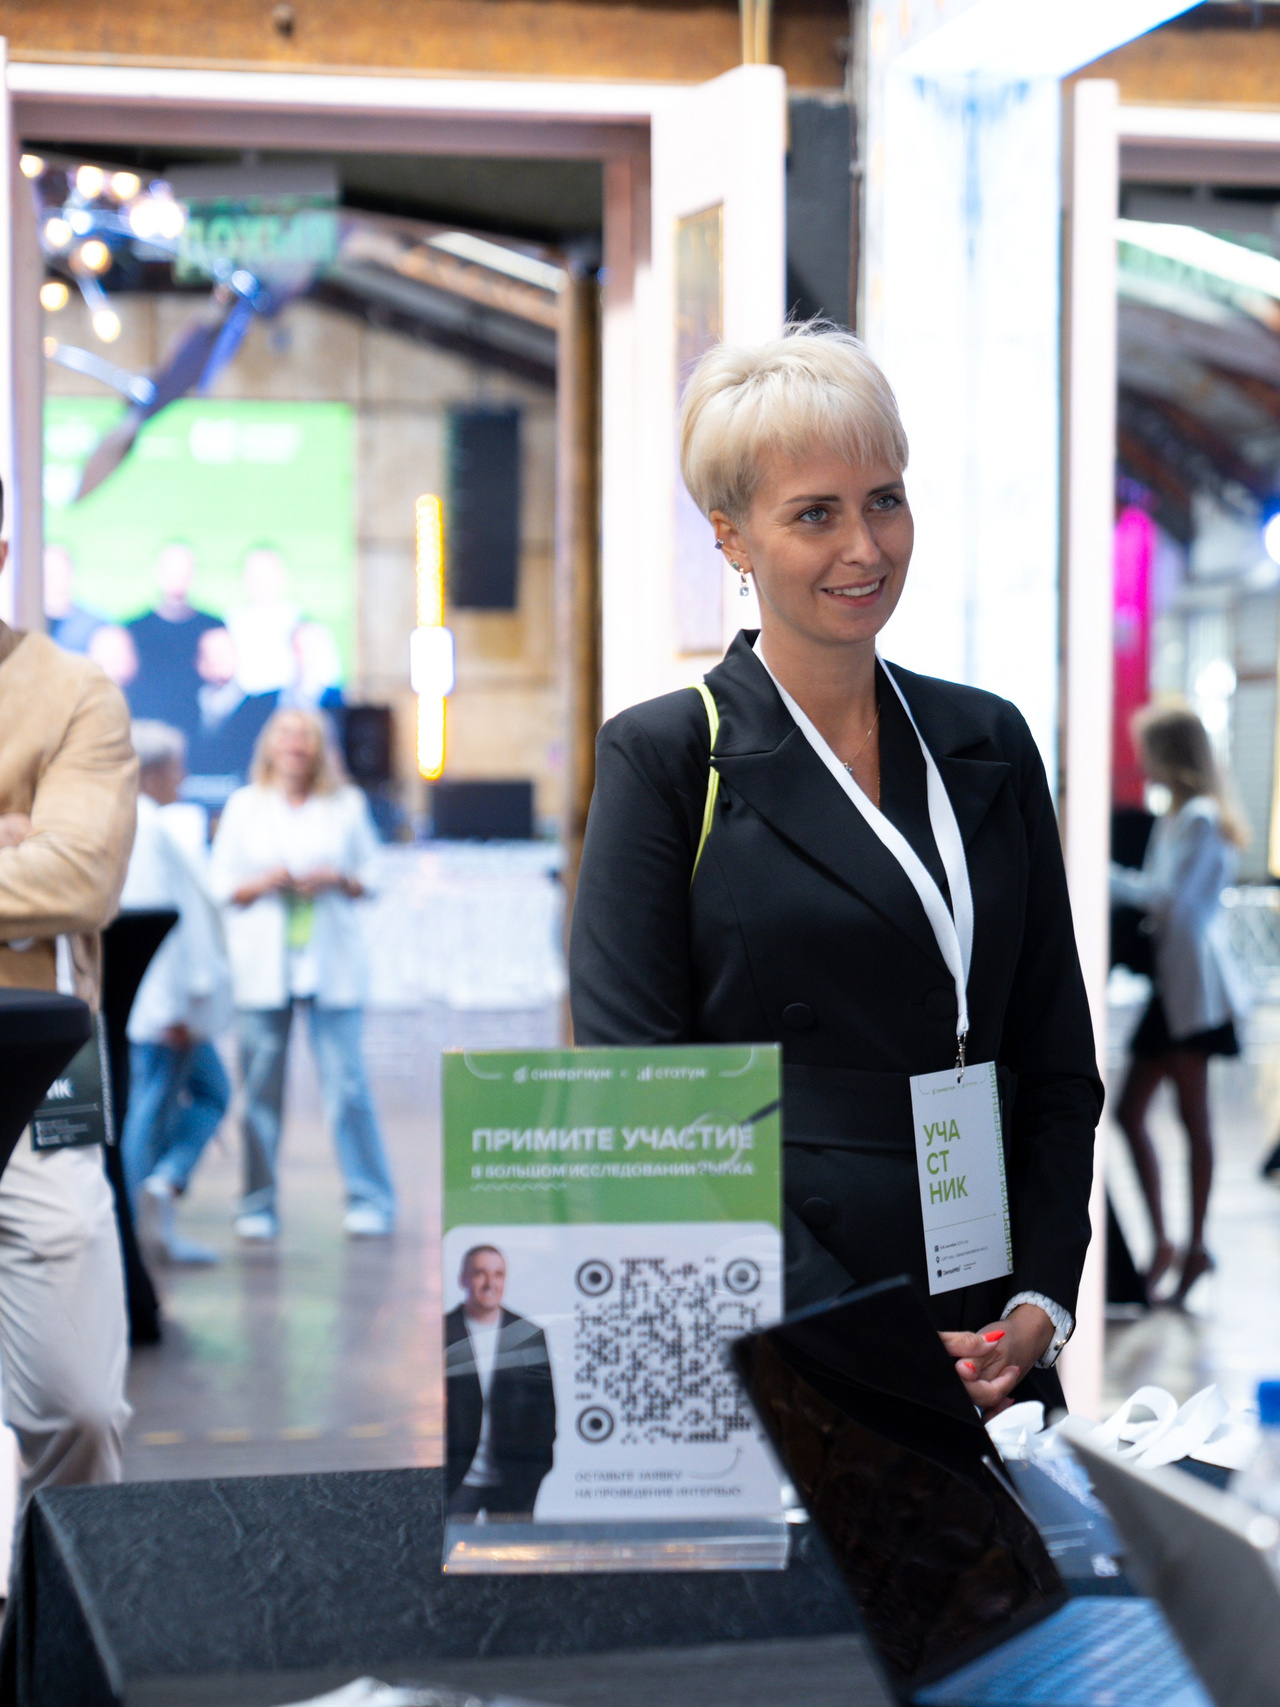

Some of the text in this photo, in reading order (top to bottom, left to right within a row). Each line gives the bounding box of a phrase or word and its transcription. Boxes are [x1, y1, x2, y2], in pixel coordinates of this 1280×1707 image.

[530, 1067, 612, 1082] синергиум
[472, 1124, 754, 1152] ПРИМИТЕ УЧАСТИЕ
[923, 1118, 961, 1147] УЧА
[485, 1164, 566, 1178] БОЛЬШОМ
[569, 1162, 695, 1178] ИССЛЕДОВАНИИ
[926, 1150, 950, 1175] СТ
[988, 1063, 1014, 1273] СИНЕРГИУМ КОНФЕРЕНЦИЯ
[929, 1175, 968, 1205] НИК
[575, 1469, 682, 1483] ОСТАВЬТЕ ЗАЯВКУ
[574, 1486, 741, 1499] НА ПРОВЕДЕНИЕ ИНТЕРВЬЮ
